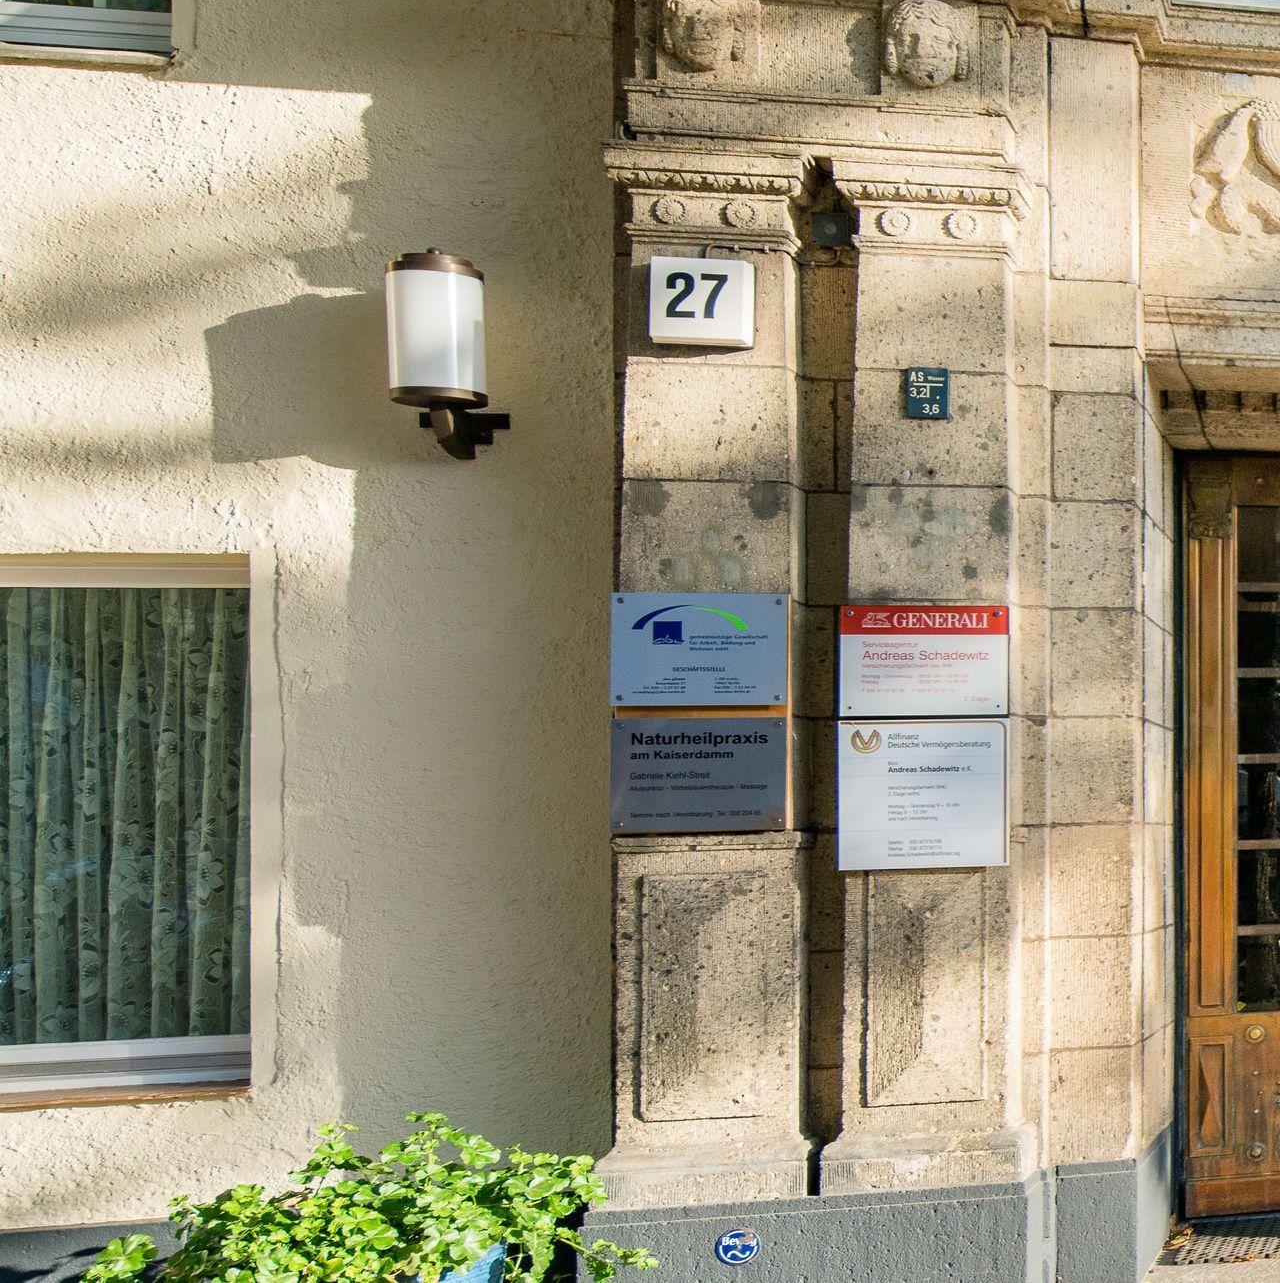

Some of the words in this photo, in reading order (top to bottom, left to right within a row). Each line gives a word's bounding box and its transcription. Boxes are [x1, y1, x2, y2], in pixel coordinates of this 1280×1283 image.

[665, 271, 729, 319] 27
[909, 371, 925, 382] AS
[893, 612, 989, 629] GENERALI
[862, 641, 919, 649] Serviceagentur
[862, 650, 915, 661] Andreas
[919, 650, 990, 661] Schadewitz
[631, 731, 769, 747] Naturheilpraxis
[921, 740, 991, 749] Vermögensberatung
[630, 751, 650, 760] am
[653, 750, 734, 760] Kaiserdamm
[919, 765, 960, 773] Schadewitz
[630, 772, 664, 780] Gabriele
[666, 771, 711, 780] Kiehl-Streit
